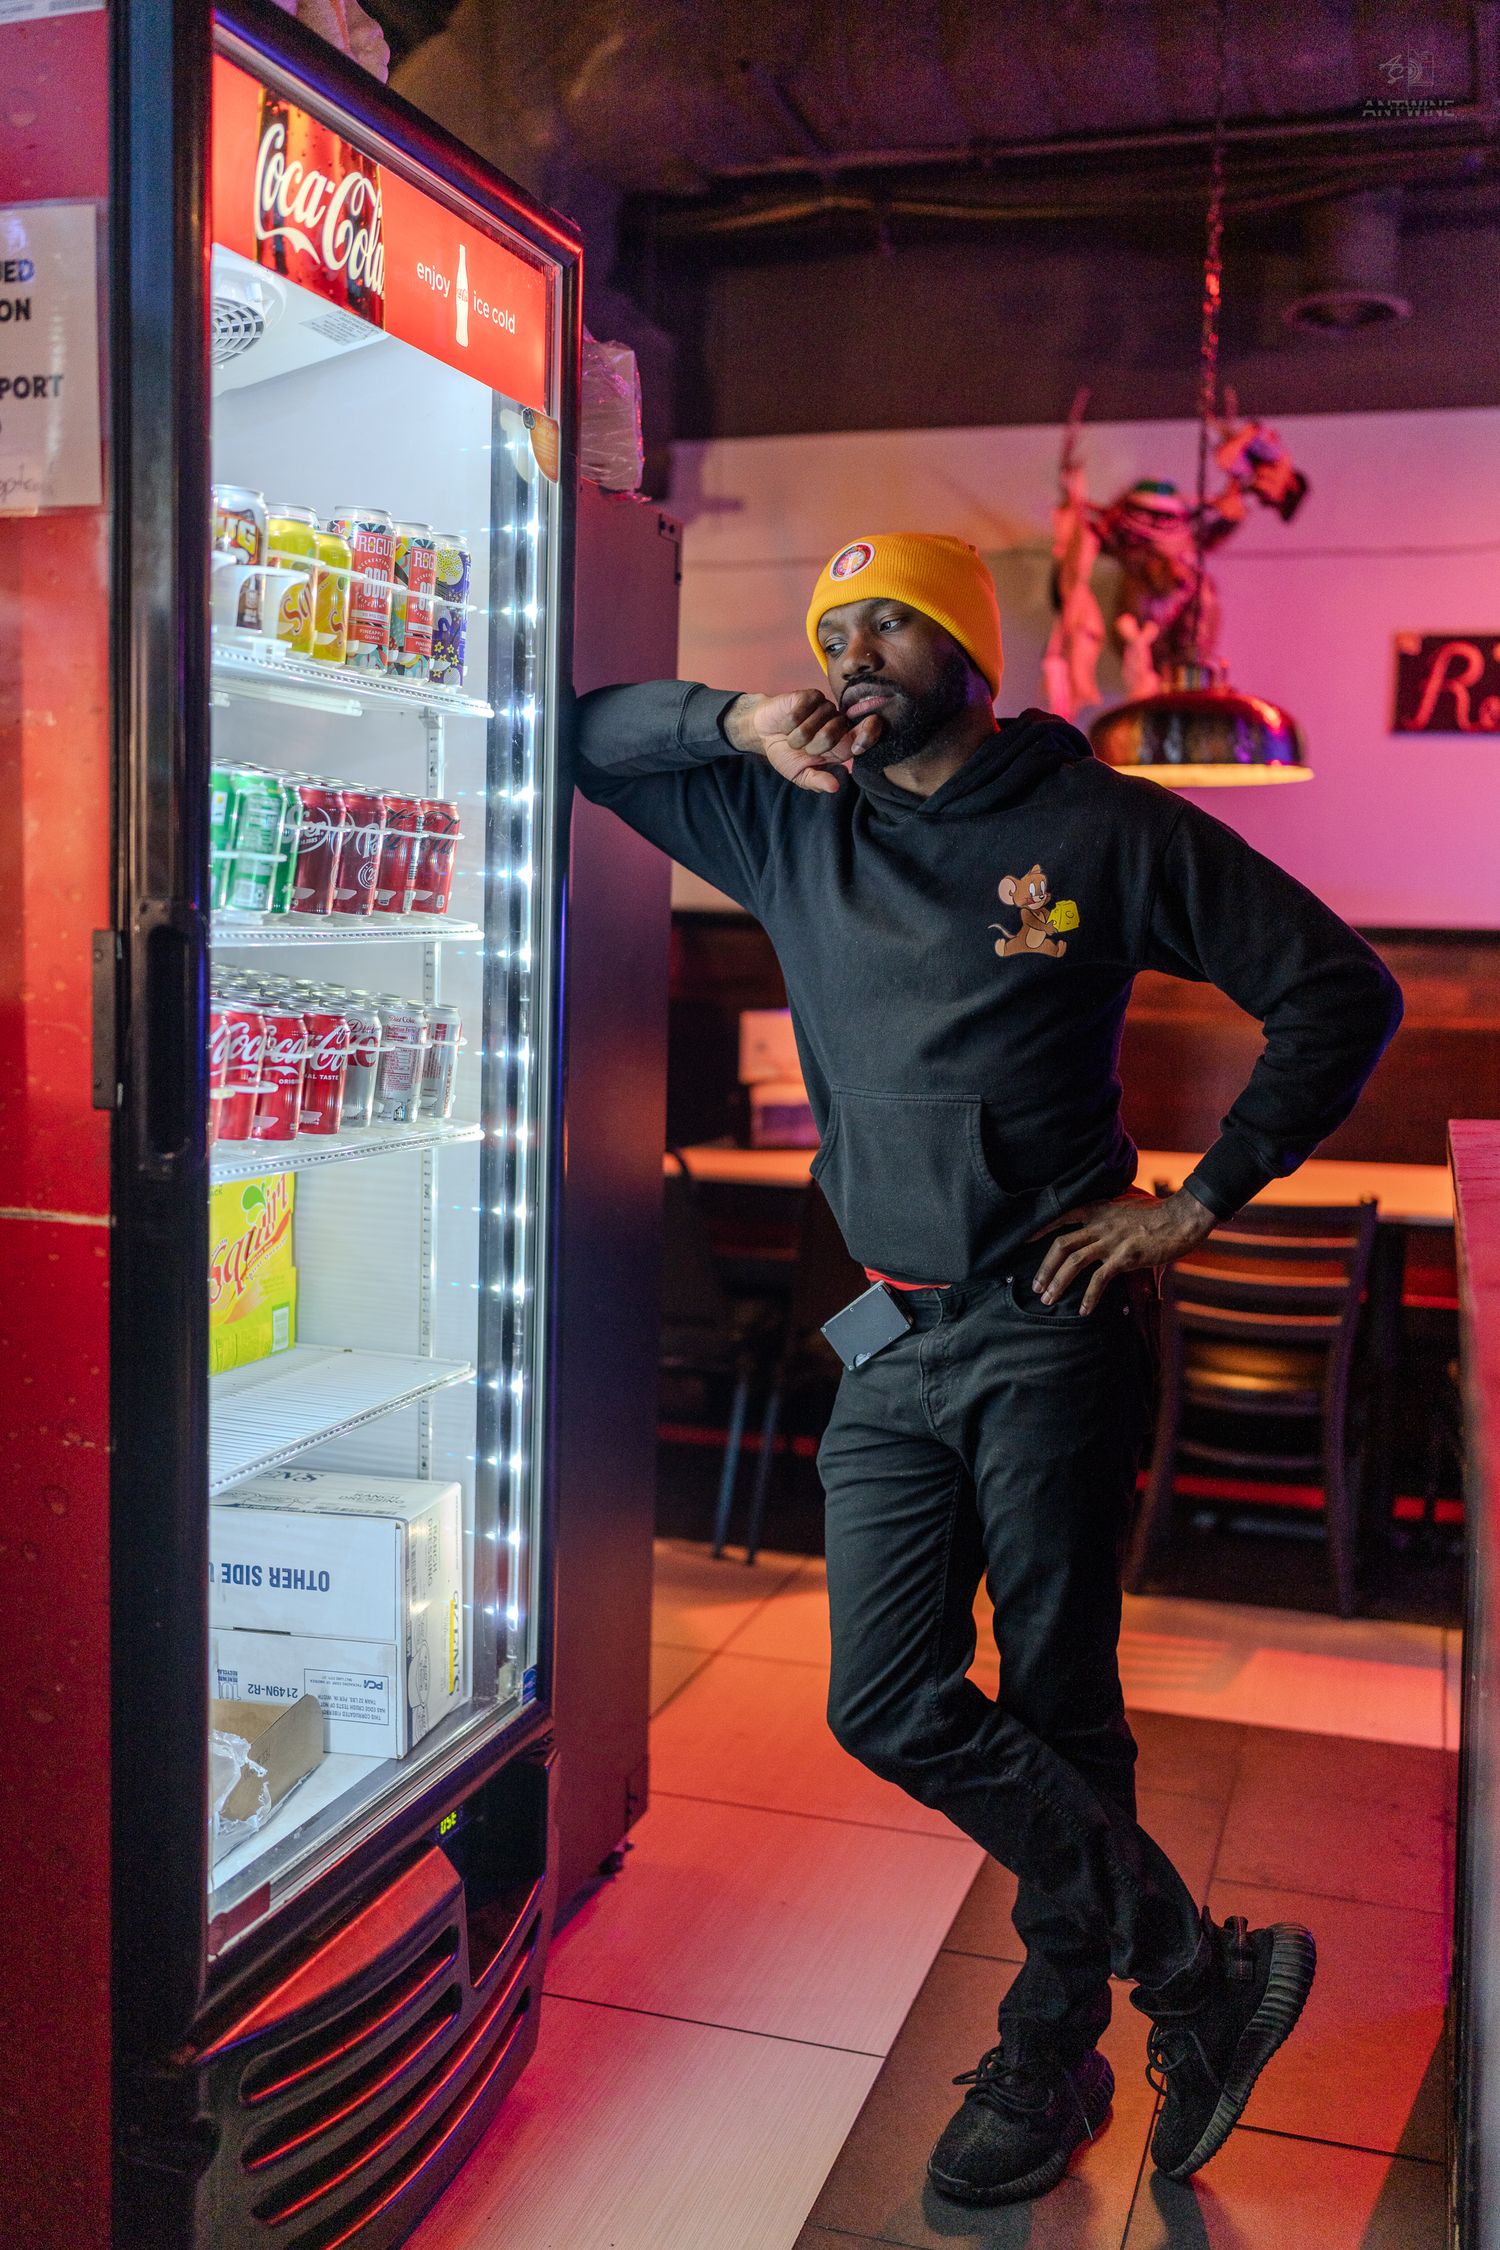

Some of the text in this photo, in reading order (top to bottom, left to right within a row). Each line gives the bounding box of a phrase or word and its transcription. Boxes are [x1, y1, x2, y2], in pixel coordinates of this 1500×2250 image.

[254, 123, 385, 300] Coca-Cola
[0, 259, 35, 283] ED
[416, 262, 451, 298] enjoy
[473, 290, 490, 319] ice
[492, 307, 516, 335] cold
[319, 1073, 341, 1082] TASTE
[221, 1563, 263, 1587] SIDE
[268, 1566, 330, 1592] OTHER
[247, 1683, 298, 1699] 2149N-R2
[363, 1679, 383, 1690] PCA
